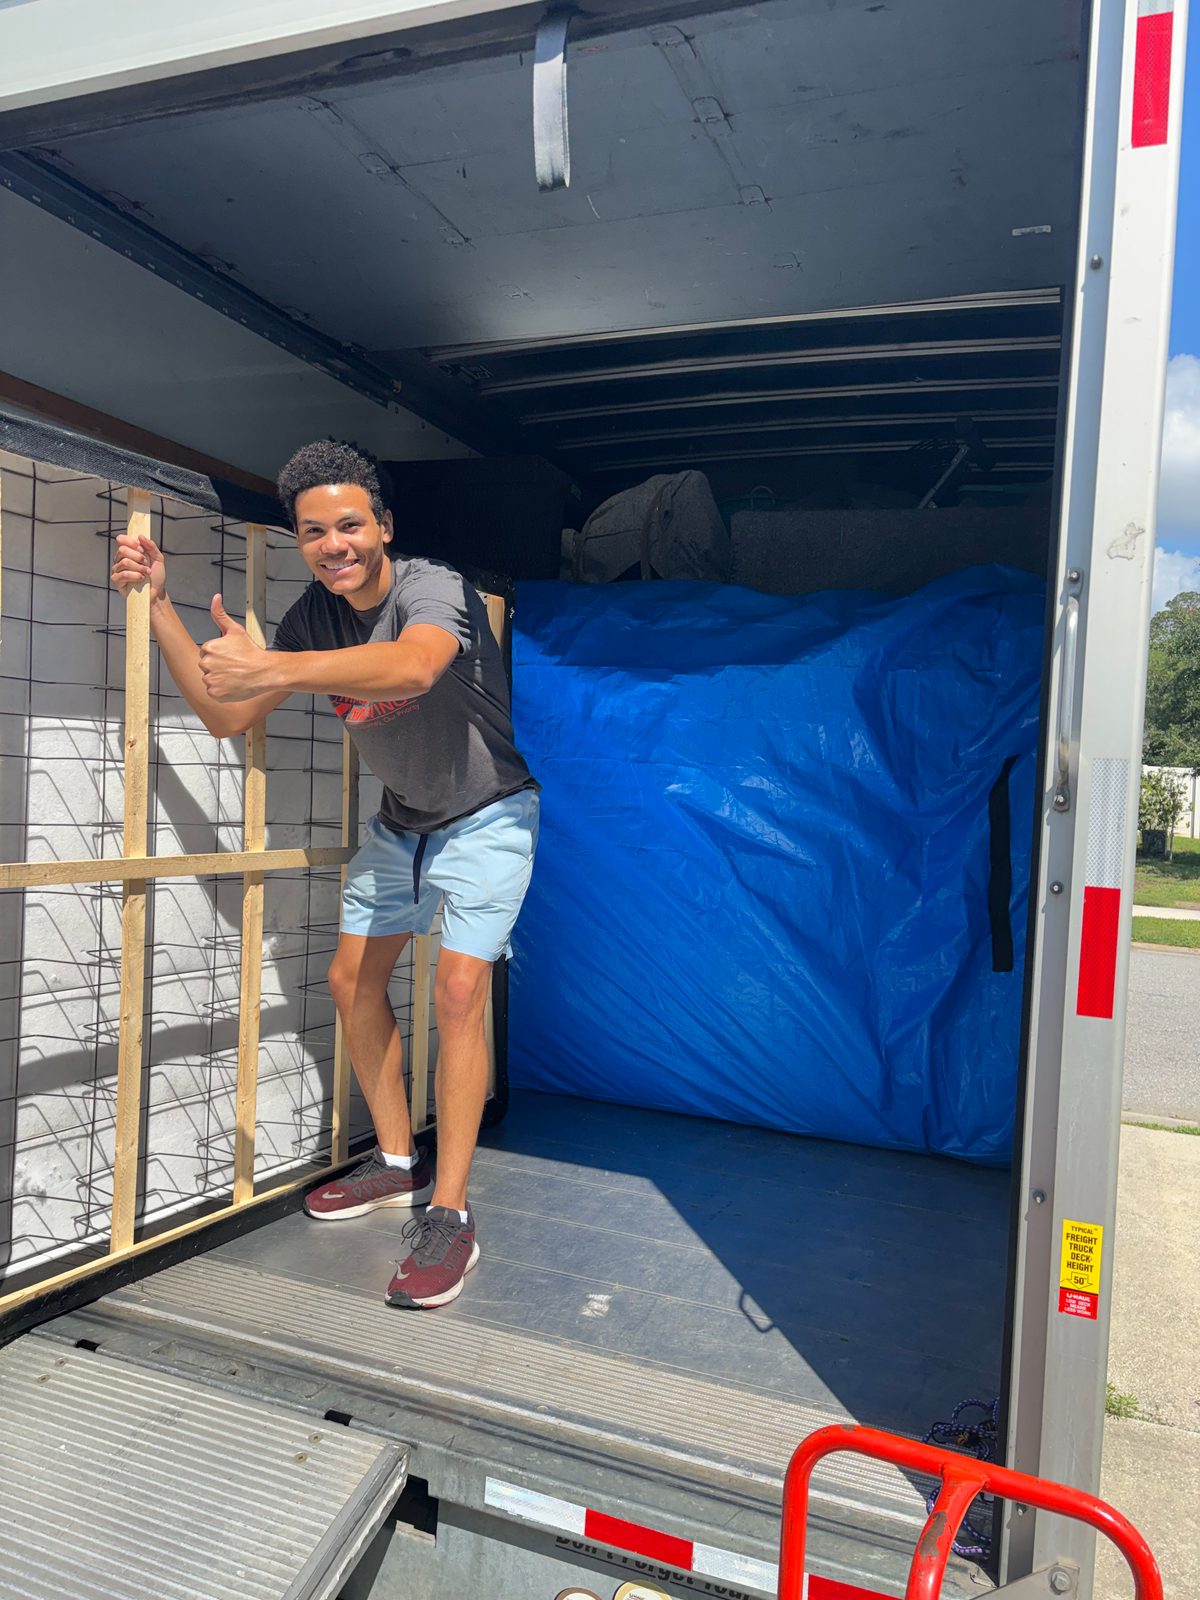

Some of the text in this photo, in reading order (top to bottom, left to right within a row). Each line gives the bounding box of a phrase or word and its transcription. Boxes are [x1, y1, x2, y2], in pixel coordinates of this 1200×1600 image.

[1071, 1226, 1093, 1234] TYPICAL
[1066, 1232, 1097, 1245] FREIGHT
[1069, 1242, 1094, 1254] TRUCK
[1066, 1260, 1093, 1272] HEIGHT
